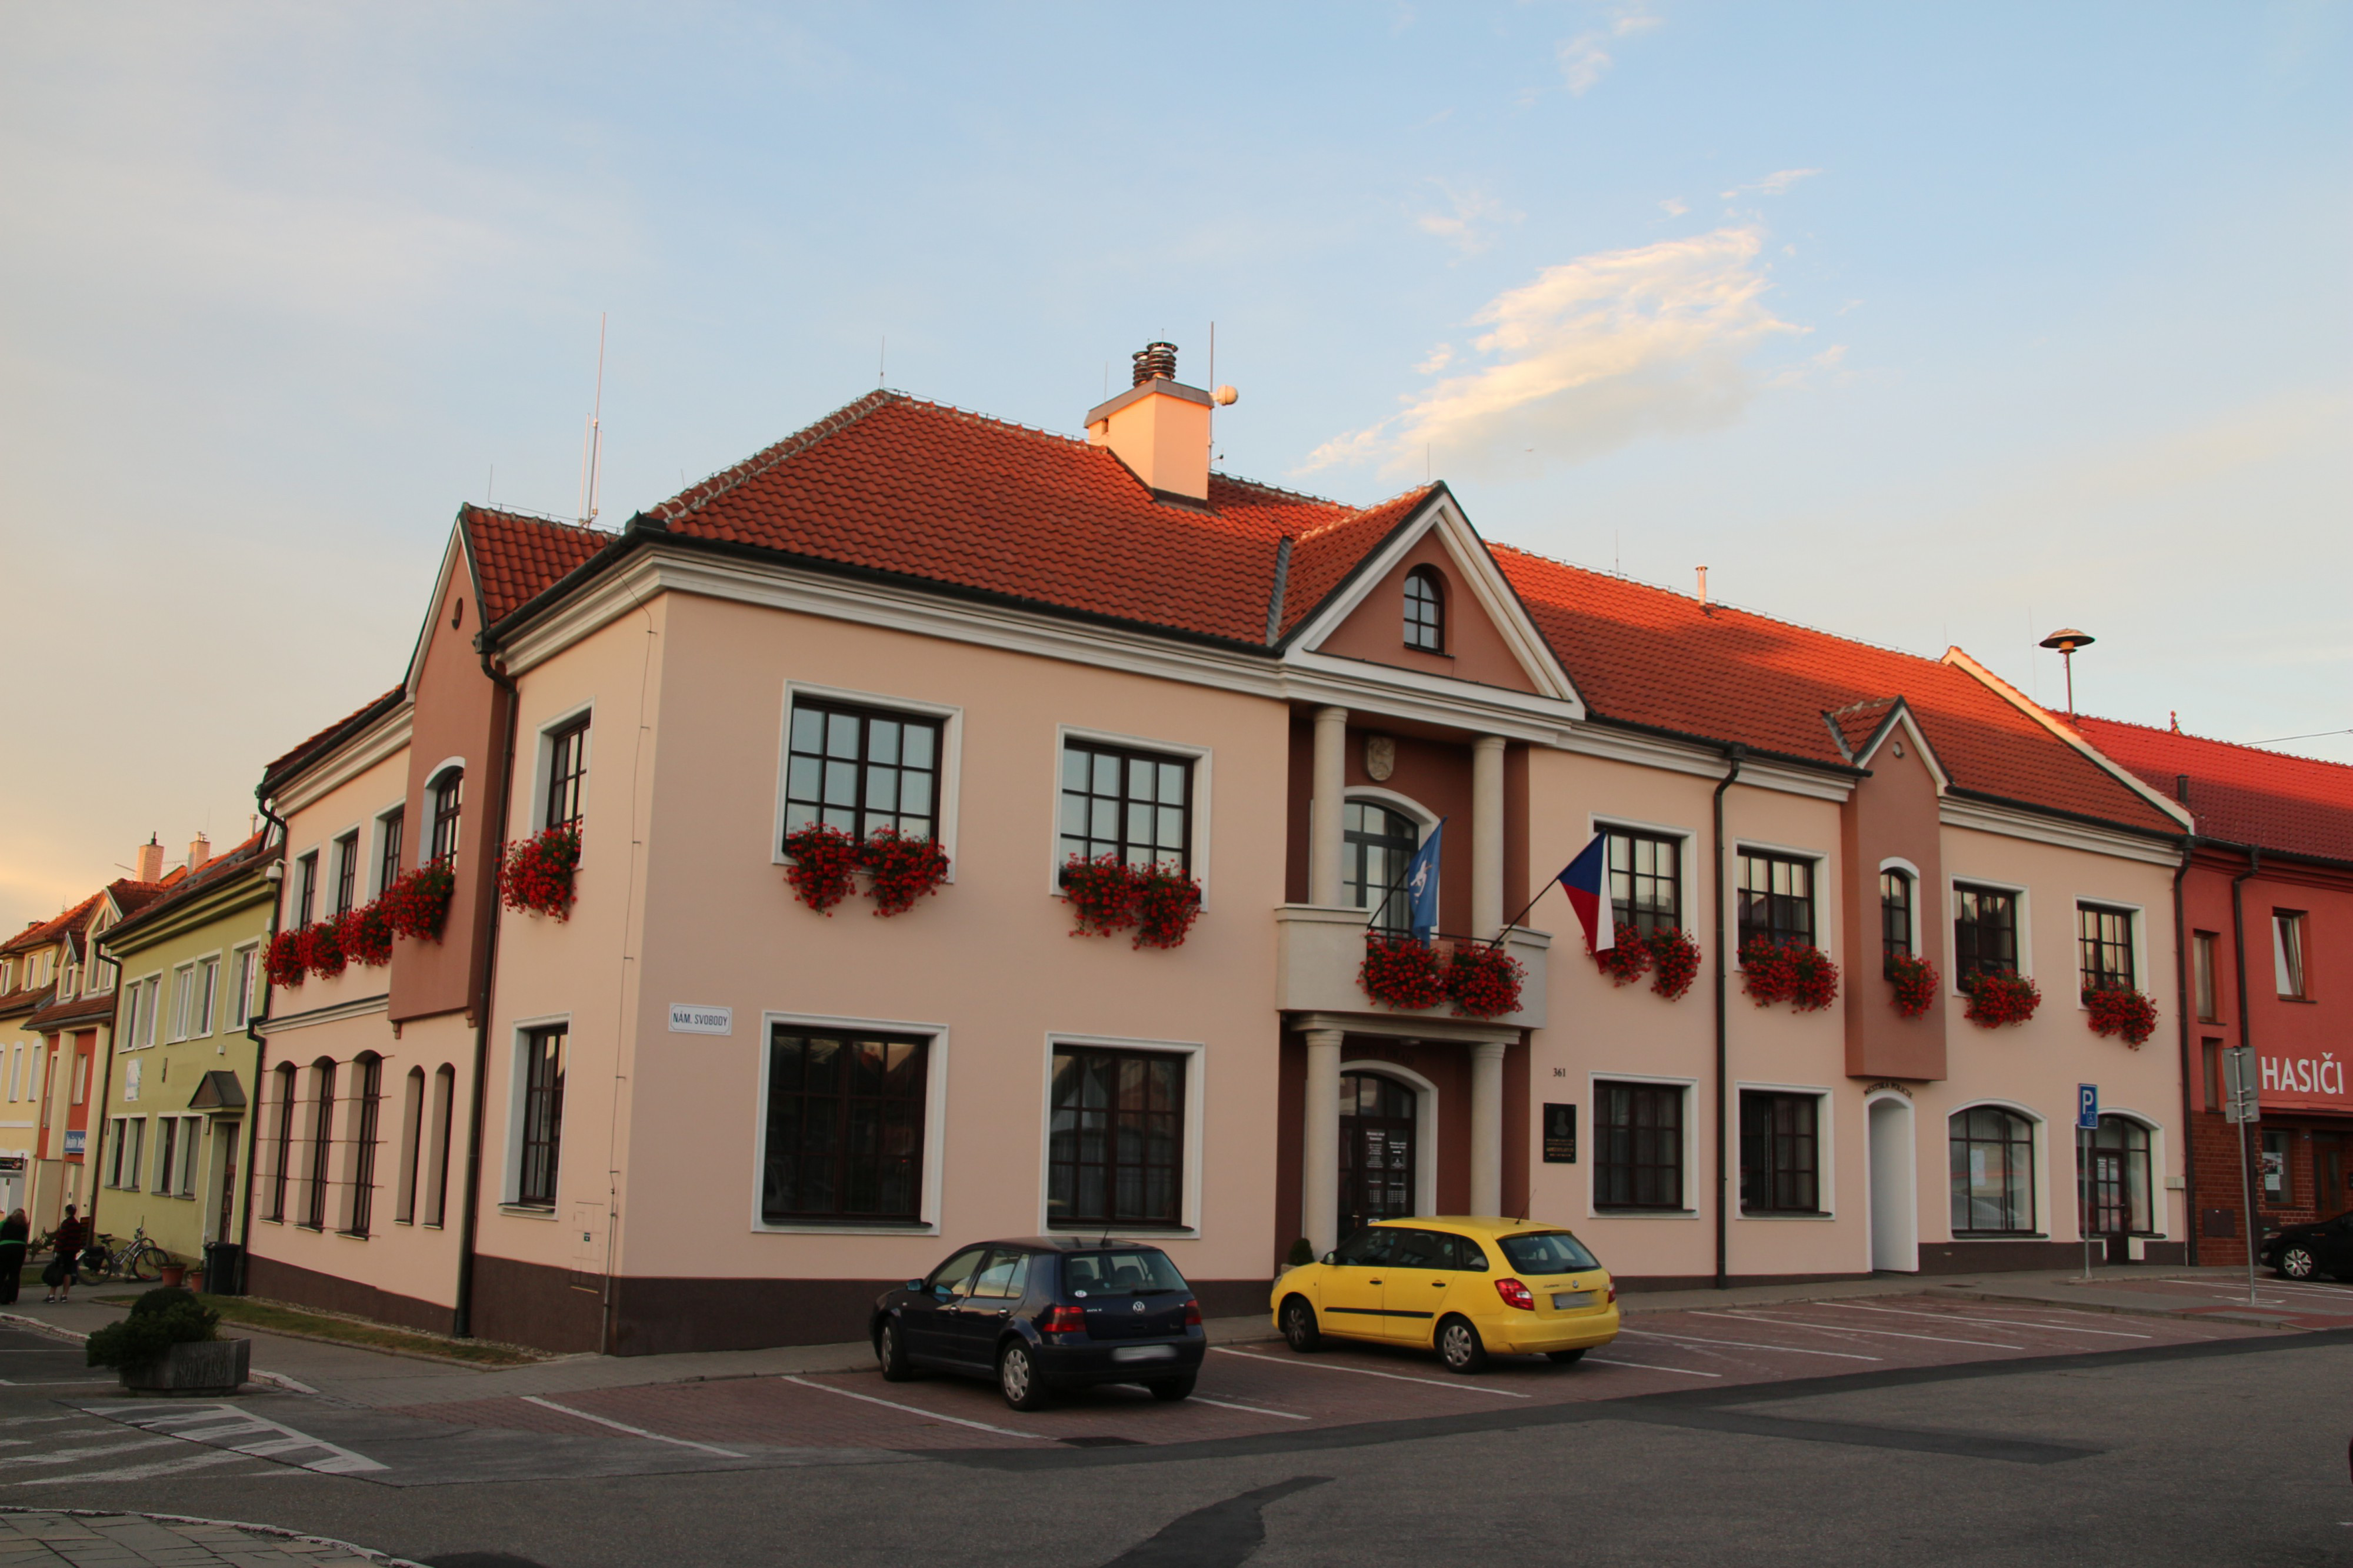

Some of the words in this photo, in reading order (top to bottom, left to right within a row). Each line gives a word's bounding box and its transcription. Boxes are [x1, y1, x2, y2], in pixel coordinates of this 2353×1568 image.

[673, 1010, 692, 1024] NÁM.
[694, 1014, 728, 1026] SVOBODY
[1553, 1067, 1566, 1077] 361
[2261, 1052, 2344, 1095] HASIČI
[2082, 1090, 2094, 1115] P
